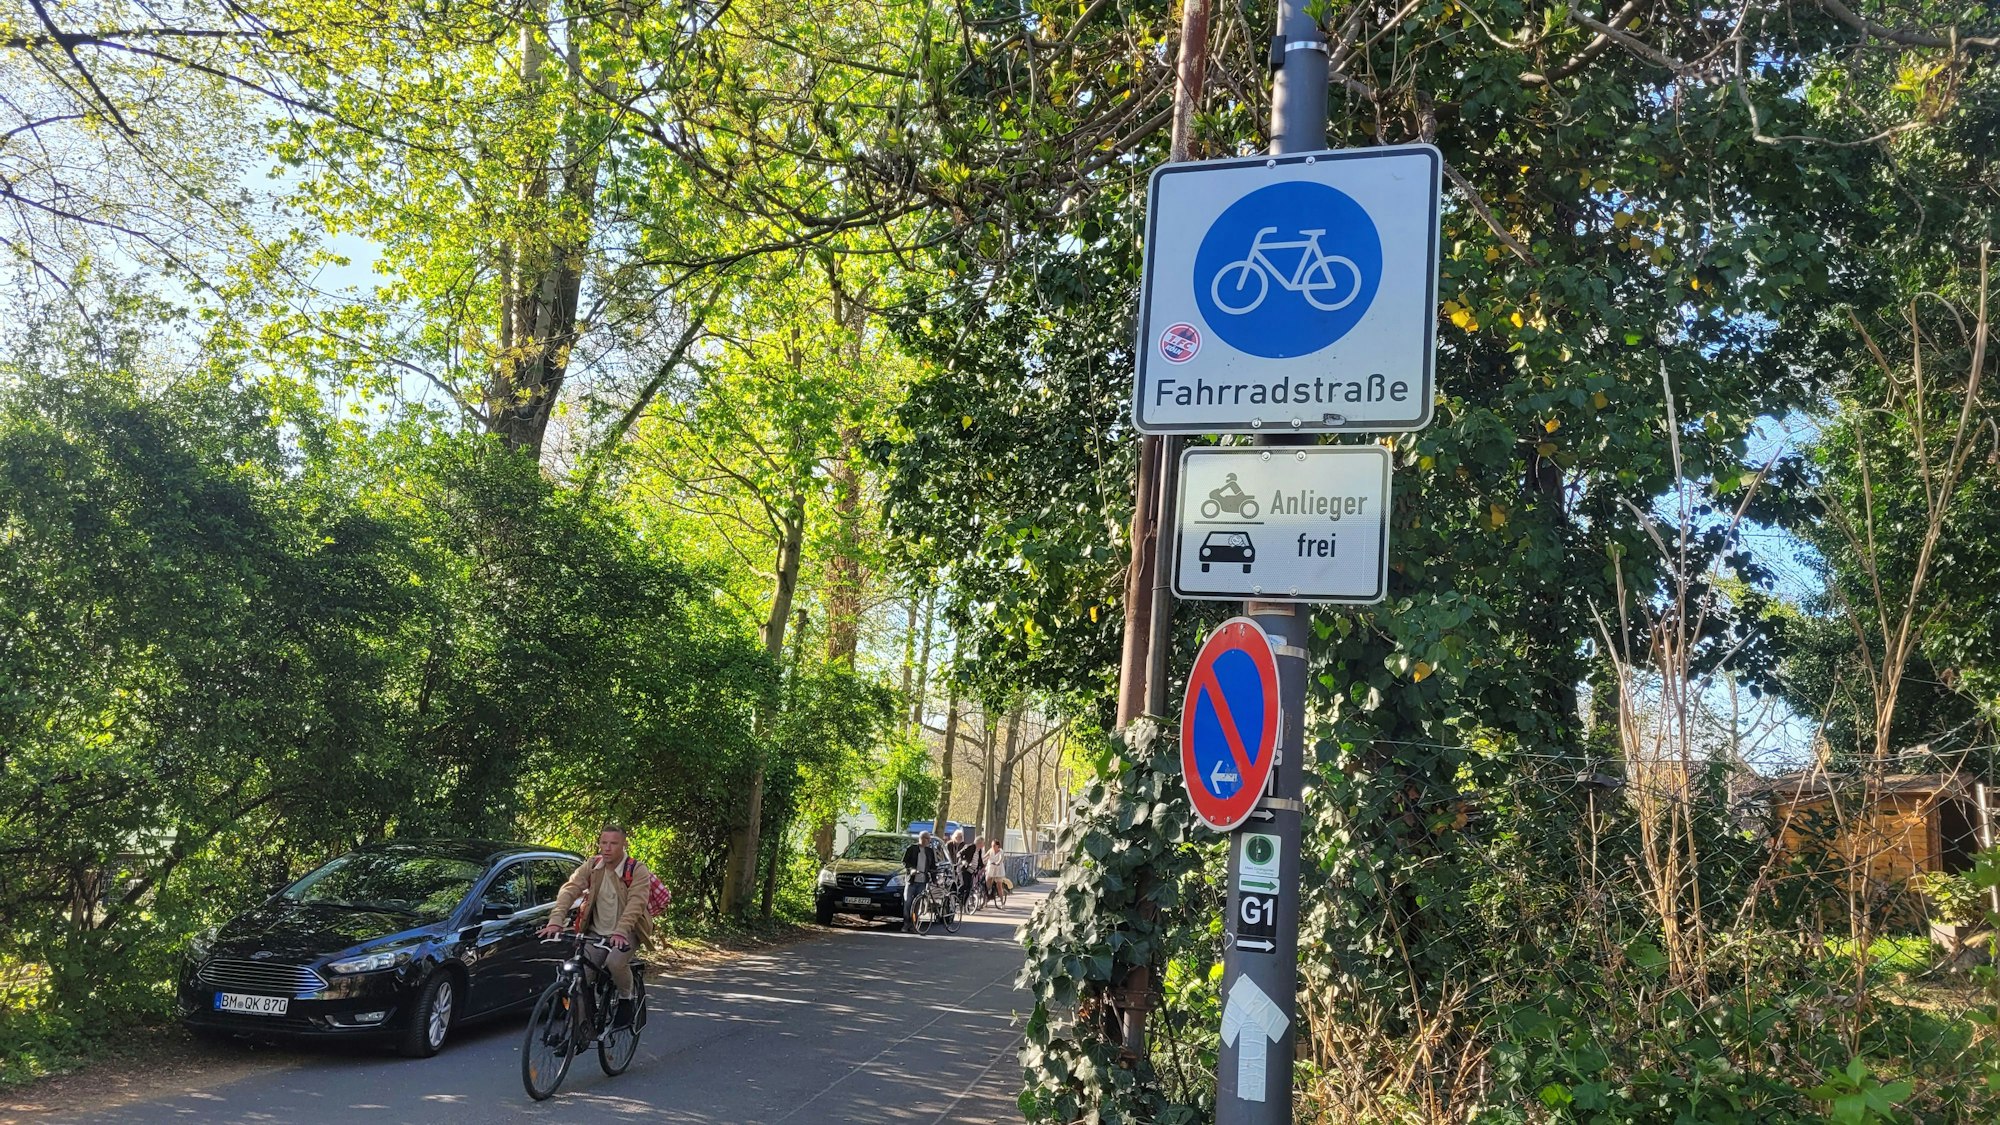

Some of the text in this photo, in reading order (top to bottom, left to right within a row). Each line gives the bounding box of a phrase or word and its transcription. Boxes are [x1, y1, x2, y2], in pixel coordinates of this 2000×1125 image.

[1156, 373, 1409, 407] Fahrradstraße
[1270, 489, 1368, 522] Anlieger
[1297, 533, 1336, 558] frei
[1241, 896, 1274, 926] G1
[222, 995, 287, 1012] BM QK 870
